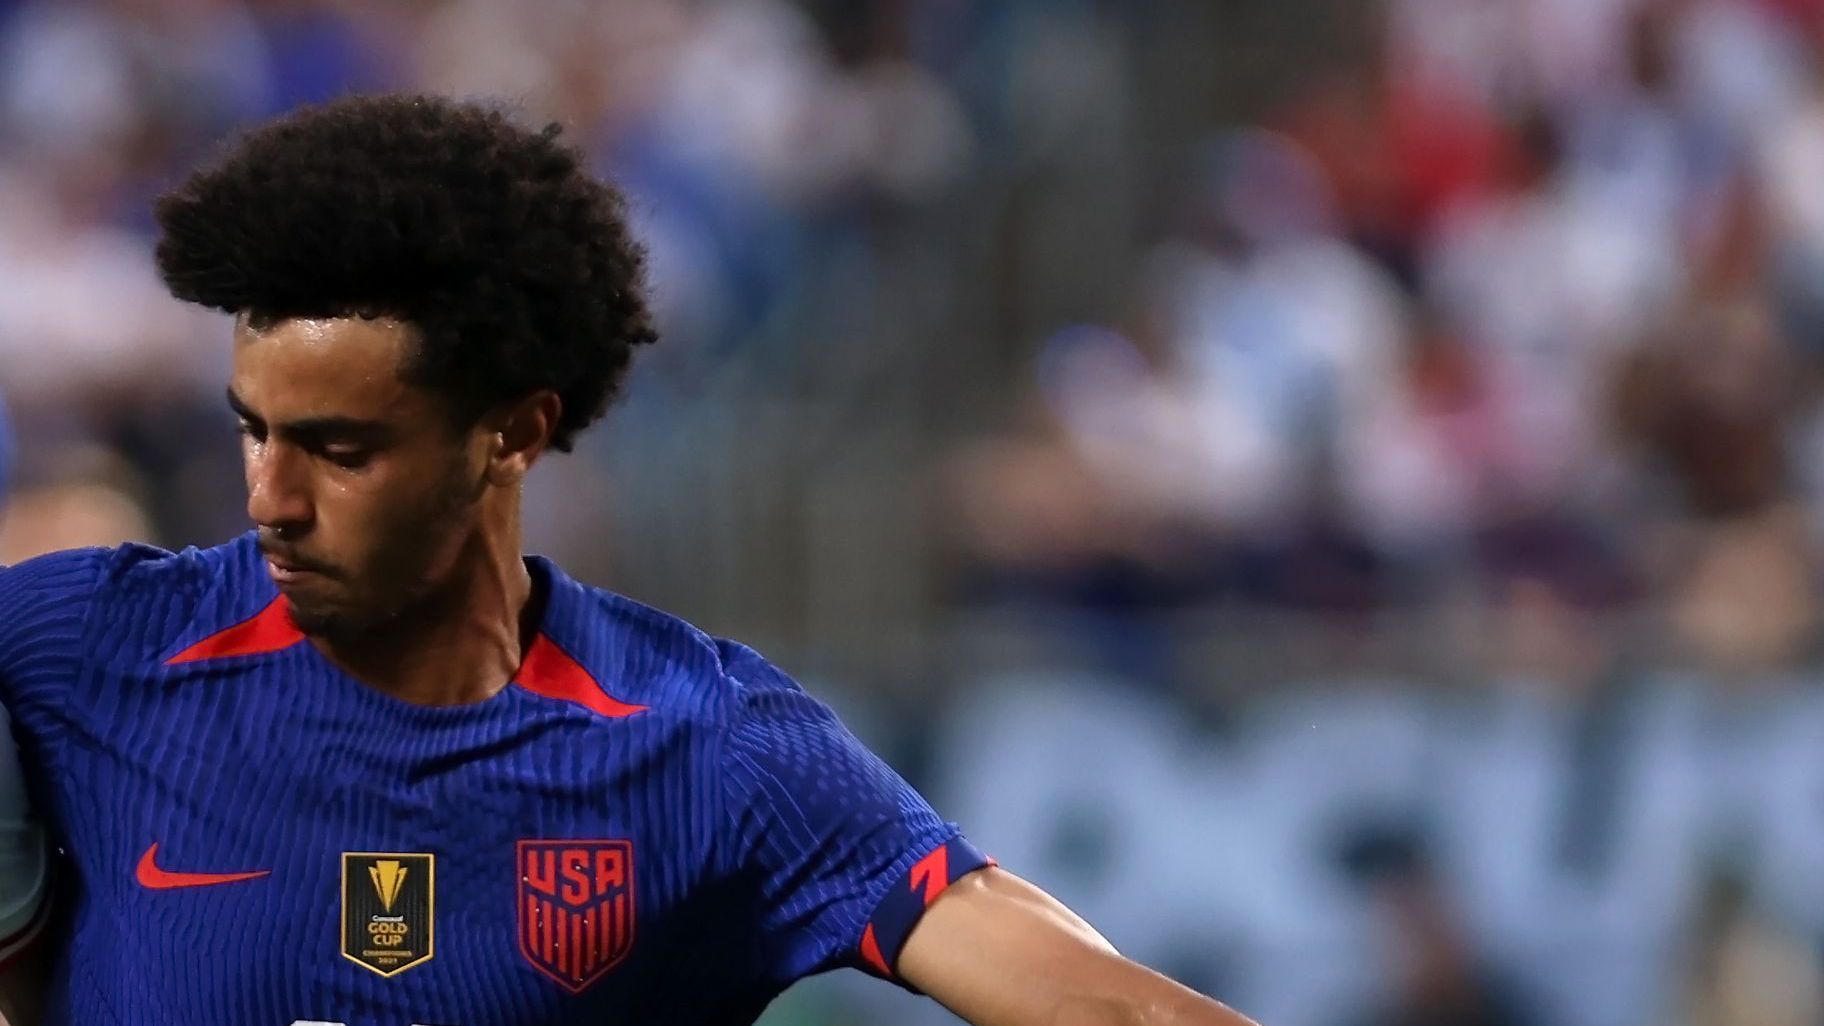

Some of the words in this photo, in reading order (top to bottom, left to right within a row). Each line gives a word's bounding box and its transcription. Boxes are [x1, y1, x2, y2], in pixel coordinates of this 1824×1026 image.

[527, 849, 625, 907] USA
[367, 922, 409, 935] GOLD
[373, 934, 404, 946] CUP
